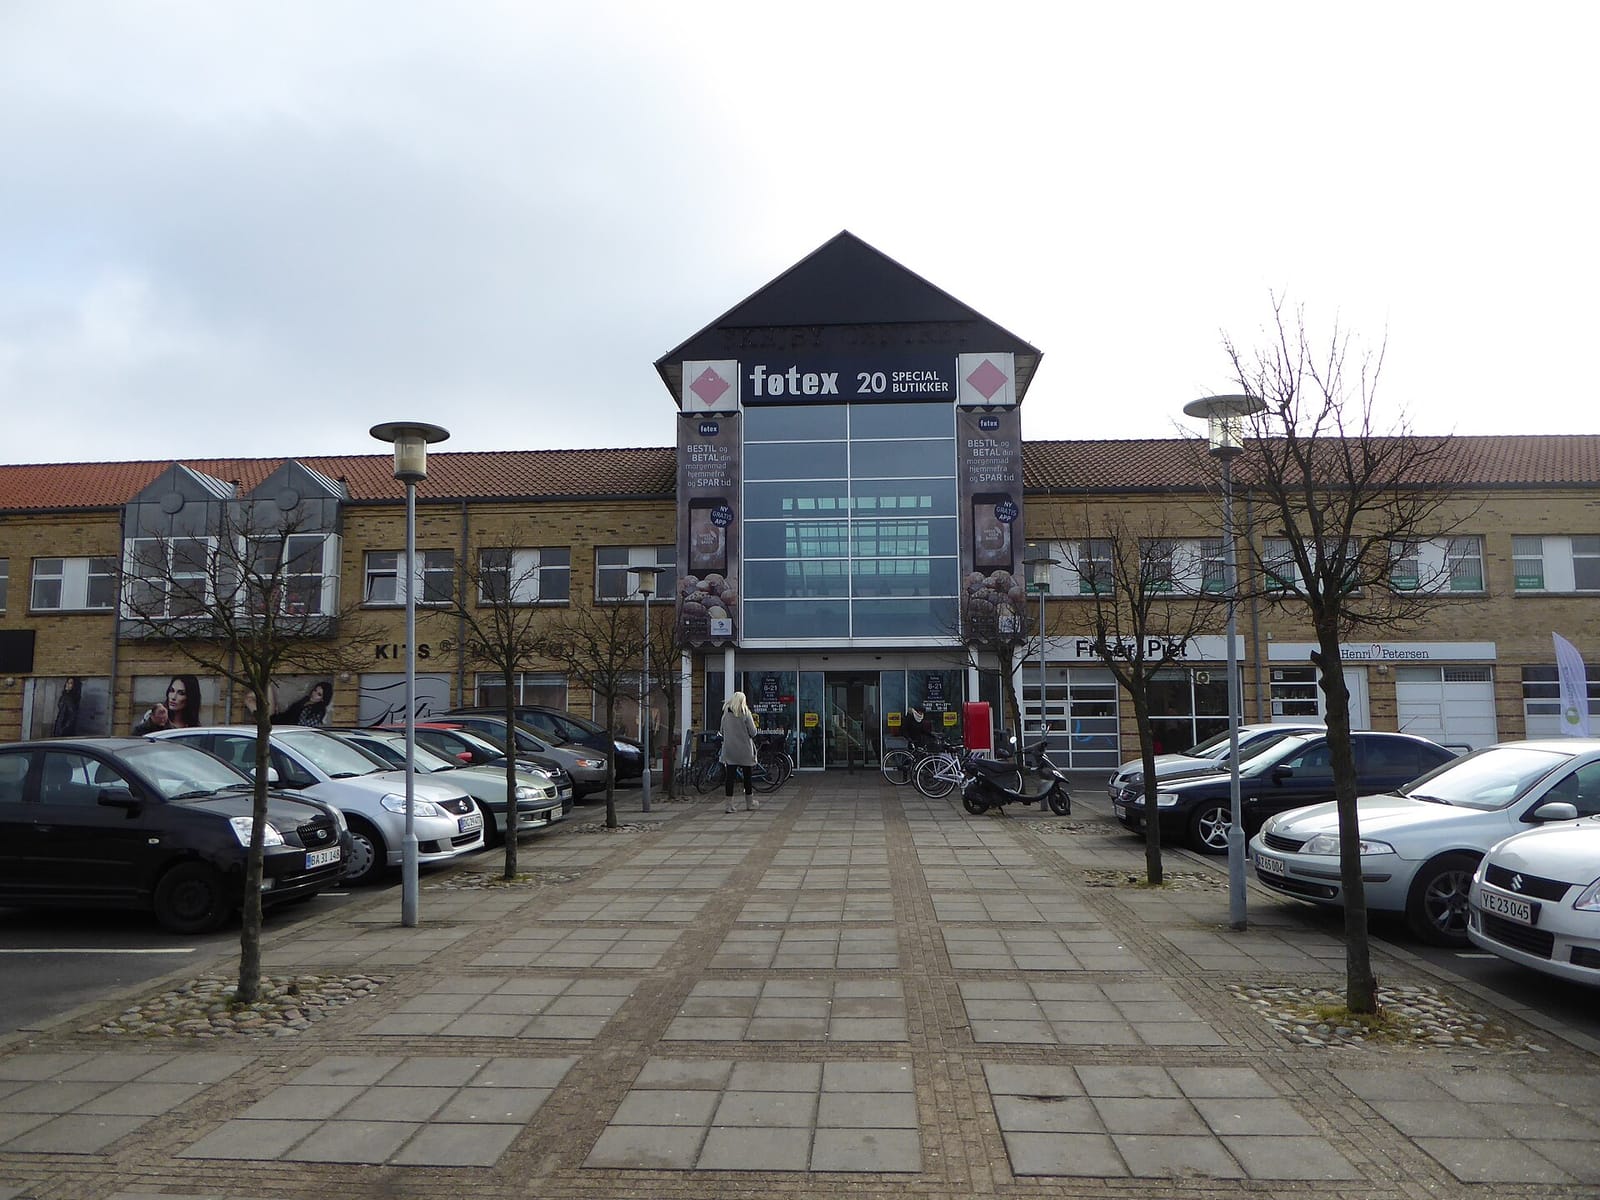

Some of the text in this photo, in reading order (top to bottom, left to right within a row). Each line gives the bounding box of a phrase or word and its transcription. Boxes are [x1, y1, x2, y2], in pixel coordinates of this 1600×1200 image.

[750, 364, 887, 396] føtex 20
[892, 371, 939, 382] SPECIAL
[892, 381, 949, 393] BUTIKKER
[968, 439, 1010, 449] BESTIL og
[687, 445, 728, 454] BESTIL og
[973, 448, 1001, 456] BETAL
[692, 453, 731, 462] BETAL din
[967, 457, 1009, 465] morgenmad
[685, 463, 727, 471] morgenmad
[969, 465, 1008, 473] hjemmefra
[687, 471, 725, 479] hjemmefra
[980, 473, 1003, 482] SPAR
[1003, 473, 1014, 481] tid
[697, 478, 720, 487] SPAR
[721, 478, 731, 487] tid
[712, 511, 732, 521] GRATIS
[996, 506, 1017, 517] GRATIS
[375, 643, 430, 660] KIS
[1340, 649, 1430, 659] Henri Petersen
[1482, 893, 1529, 920] YE 23 045
